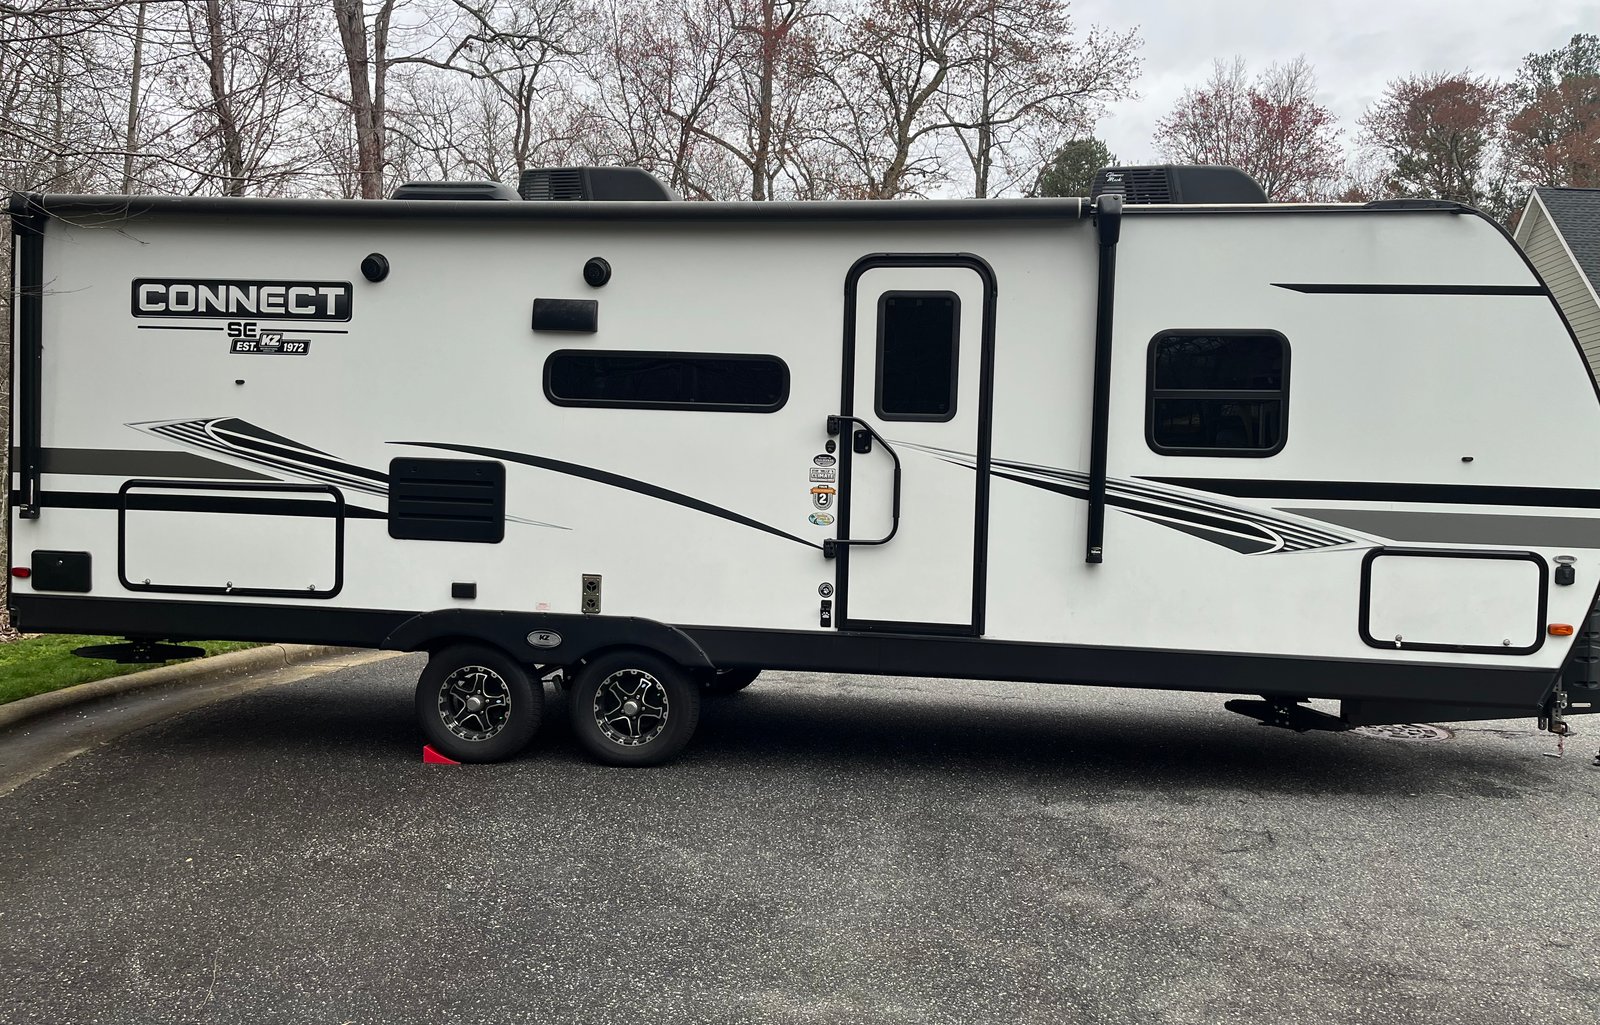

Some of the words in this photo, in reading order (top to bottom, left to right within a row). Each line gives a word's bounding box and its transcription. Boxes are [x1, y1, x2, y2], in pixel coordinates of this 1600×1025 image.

[139, 283, 345, 316] CONNECT
[227, 322, 257, 338] SE
[261, 334, 281, 346] KZ
[236, 342, 257, 352] EST.
[283, 343, 305, 352] 1972
[818, 493, 827, 504] 2
